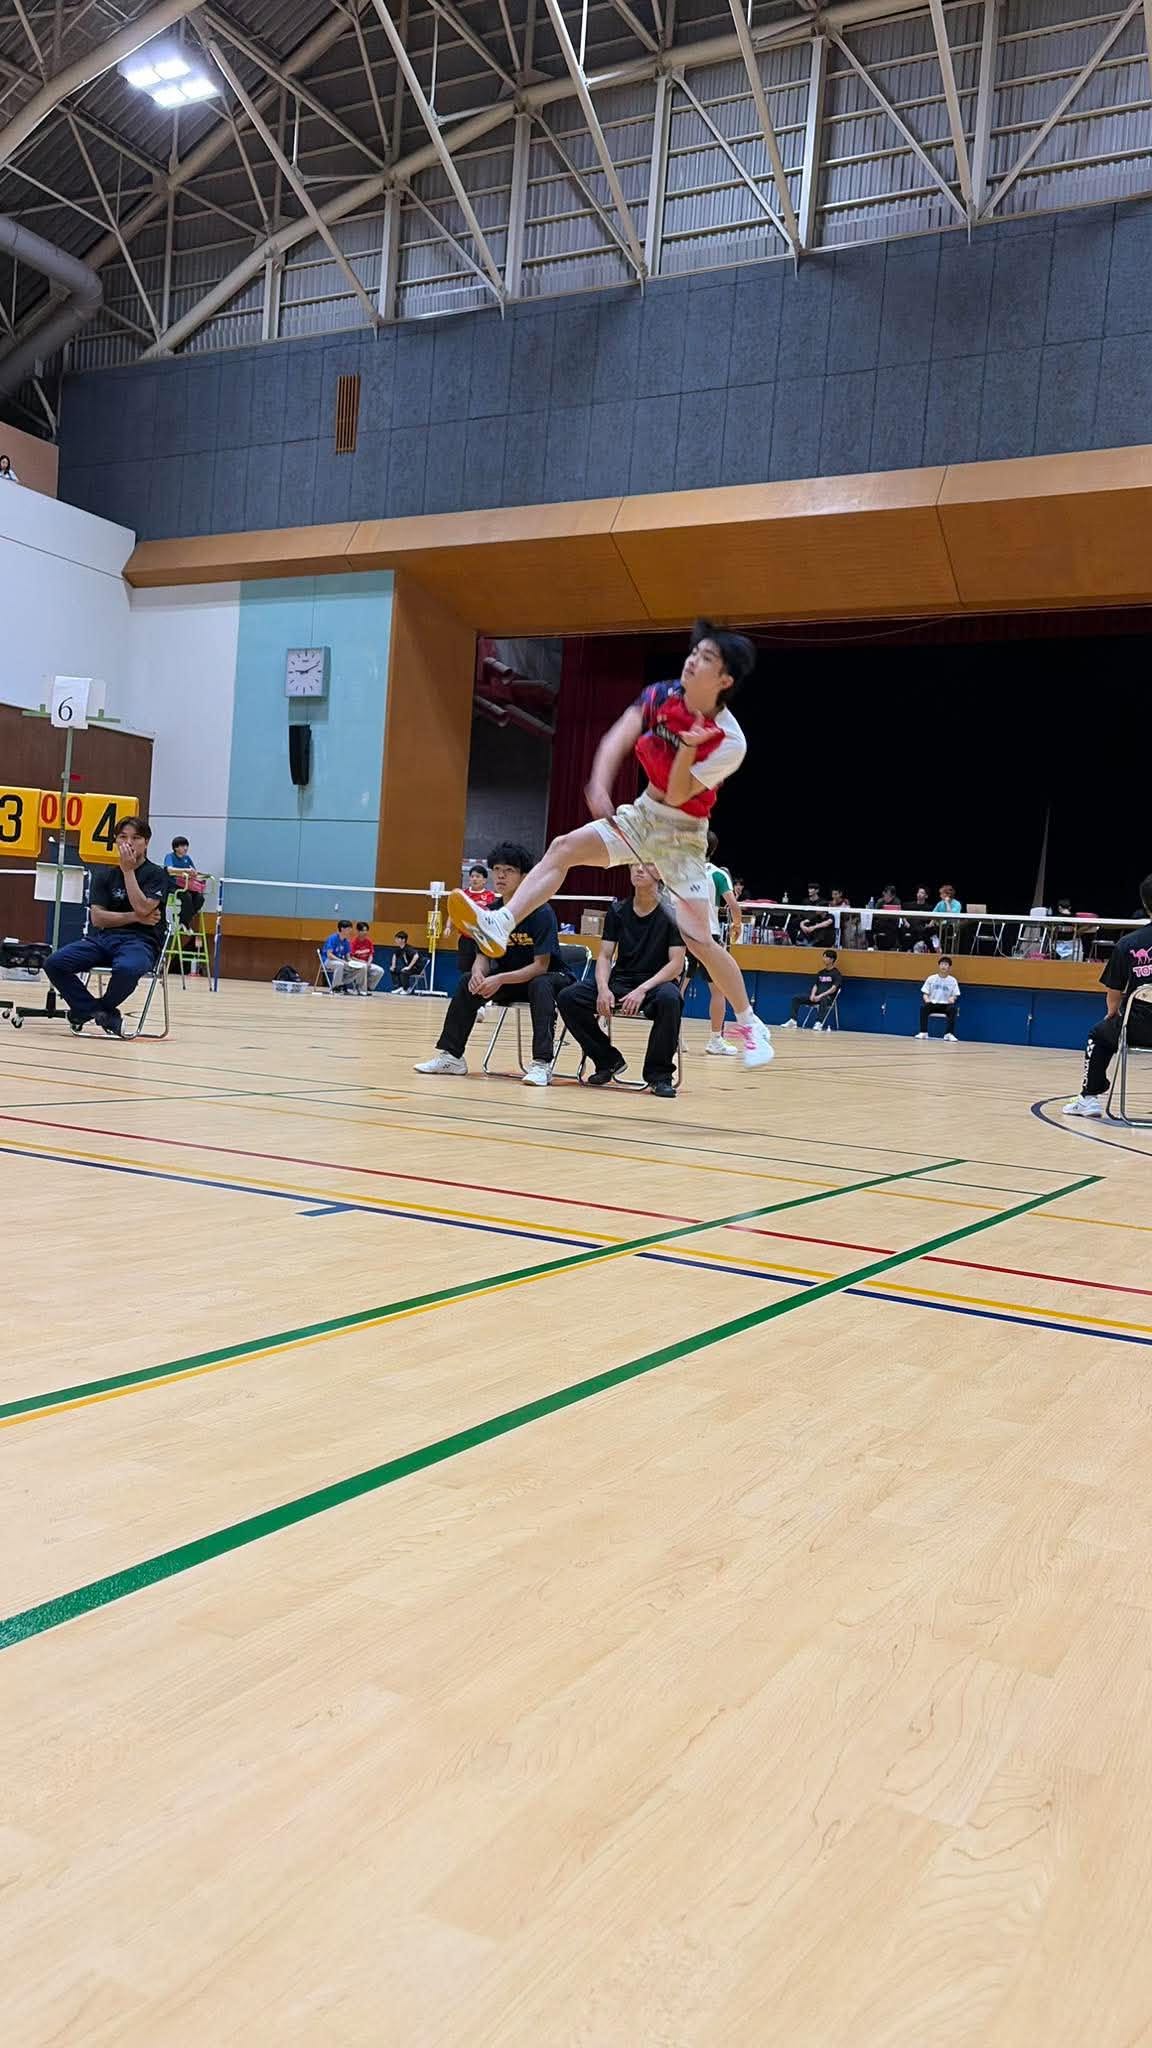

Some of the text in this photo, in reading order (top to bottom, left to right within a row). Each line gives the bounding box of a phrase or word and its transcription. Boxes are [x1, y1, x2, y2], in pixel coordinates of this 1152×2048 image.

[58, 696, 73, 721] 6
[0, 794, 117, 851] 3 0 0 4
